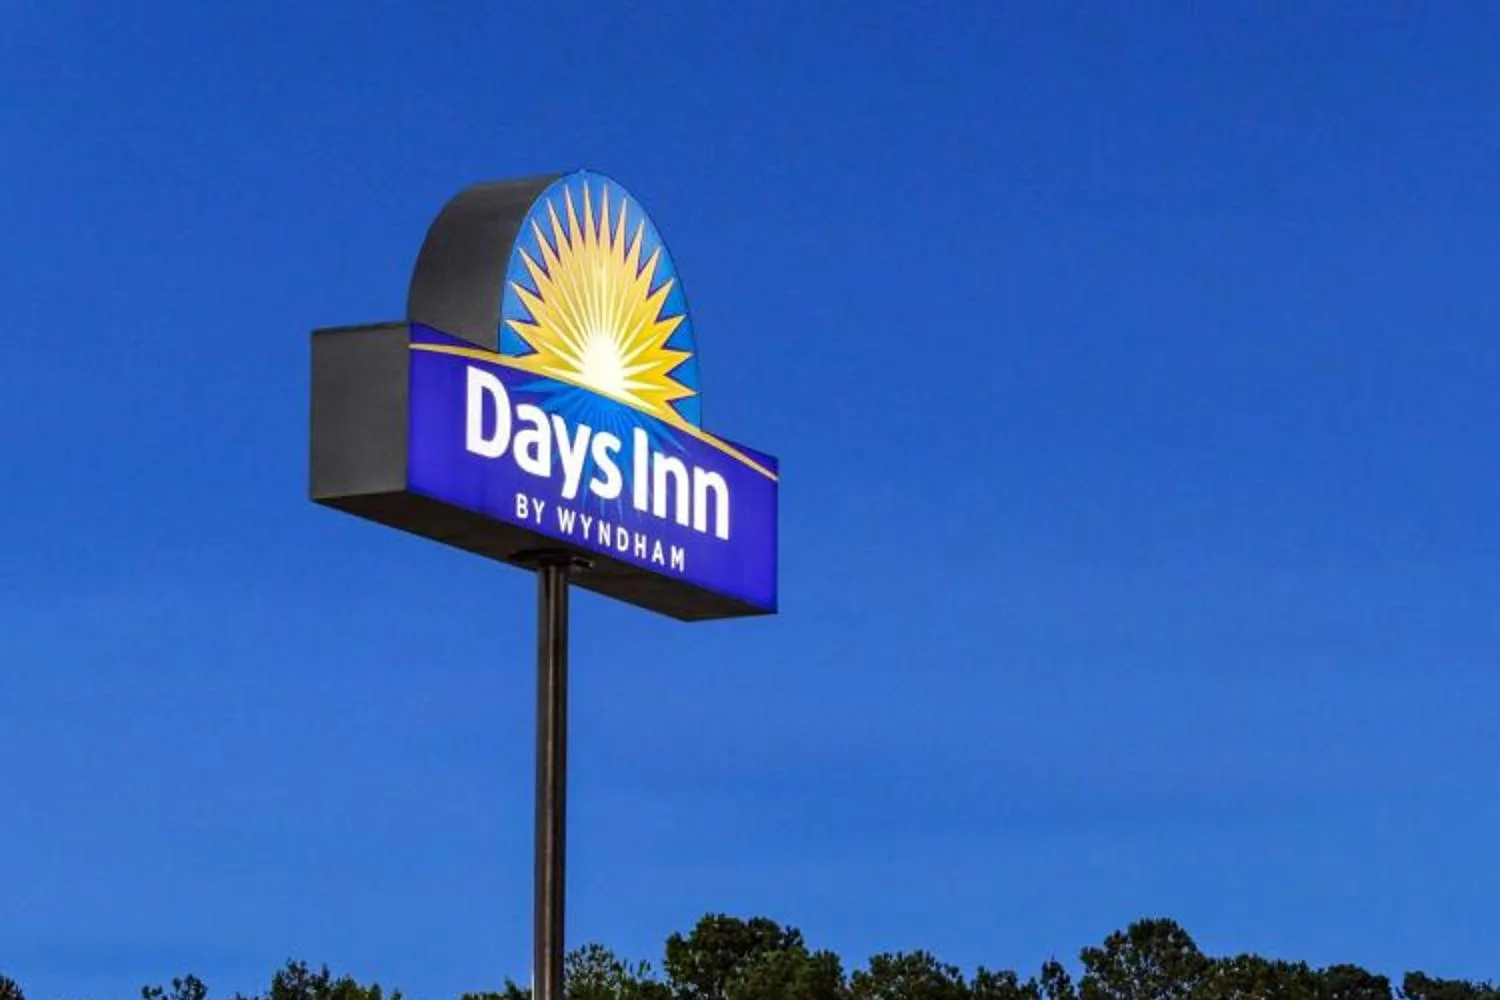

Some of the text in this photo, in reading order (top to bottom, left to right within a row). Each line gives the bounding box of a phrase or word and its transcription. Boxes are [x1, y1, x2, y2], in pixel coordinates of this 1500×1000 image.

[466, 365, 729, 541] Days Inn
[515, 493, 685, 572] BY WYNDHAM
